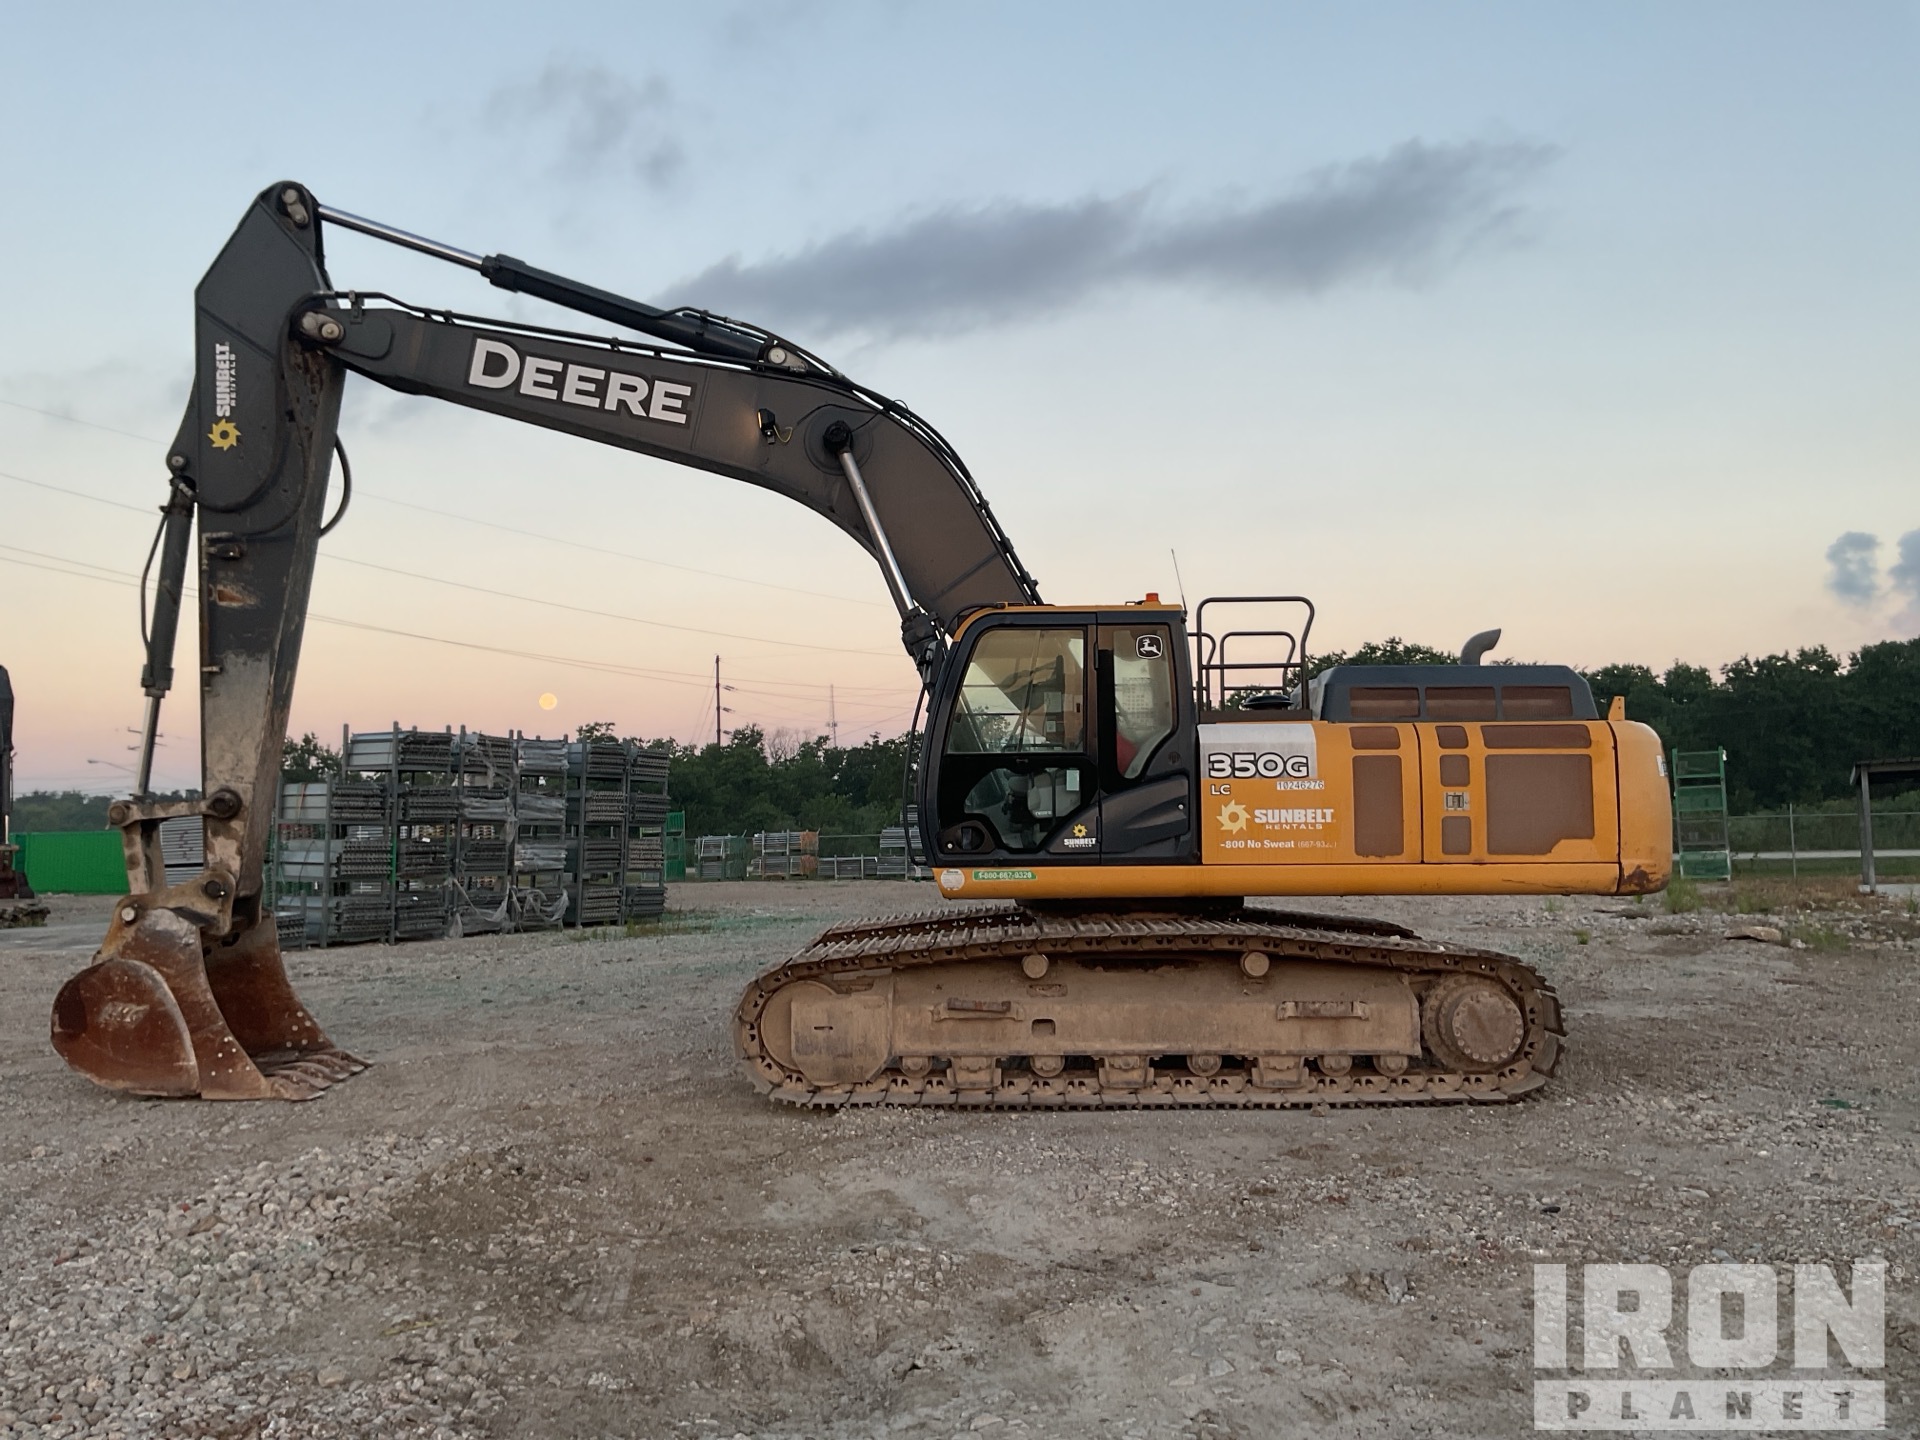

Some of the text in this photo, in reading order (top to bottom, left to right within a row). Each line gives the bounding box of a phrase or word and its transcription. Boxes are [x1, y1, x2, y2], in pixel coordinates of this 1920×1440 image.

[215, 343, 231, 417] SUNBELT
[468, 338, 692, 424] DEERE
[1208, 752, 1310, 779] 350G
[1210, 784, 1231, 795] LC
[1254, 809, 1334, 824] SUNBELT
[1063, 838, 1097, 846] SUNBELT
[1247, 840, 1262, 849] No
[1263, 840, 1295, 849] Sweat
